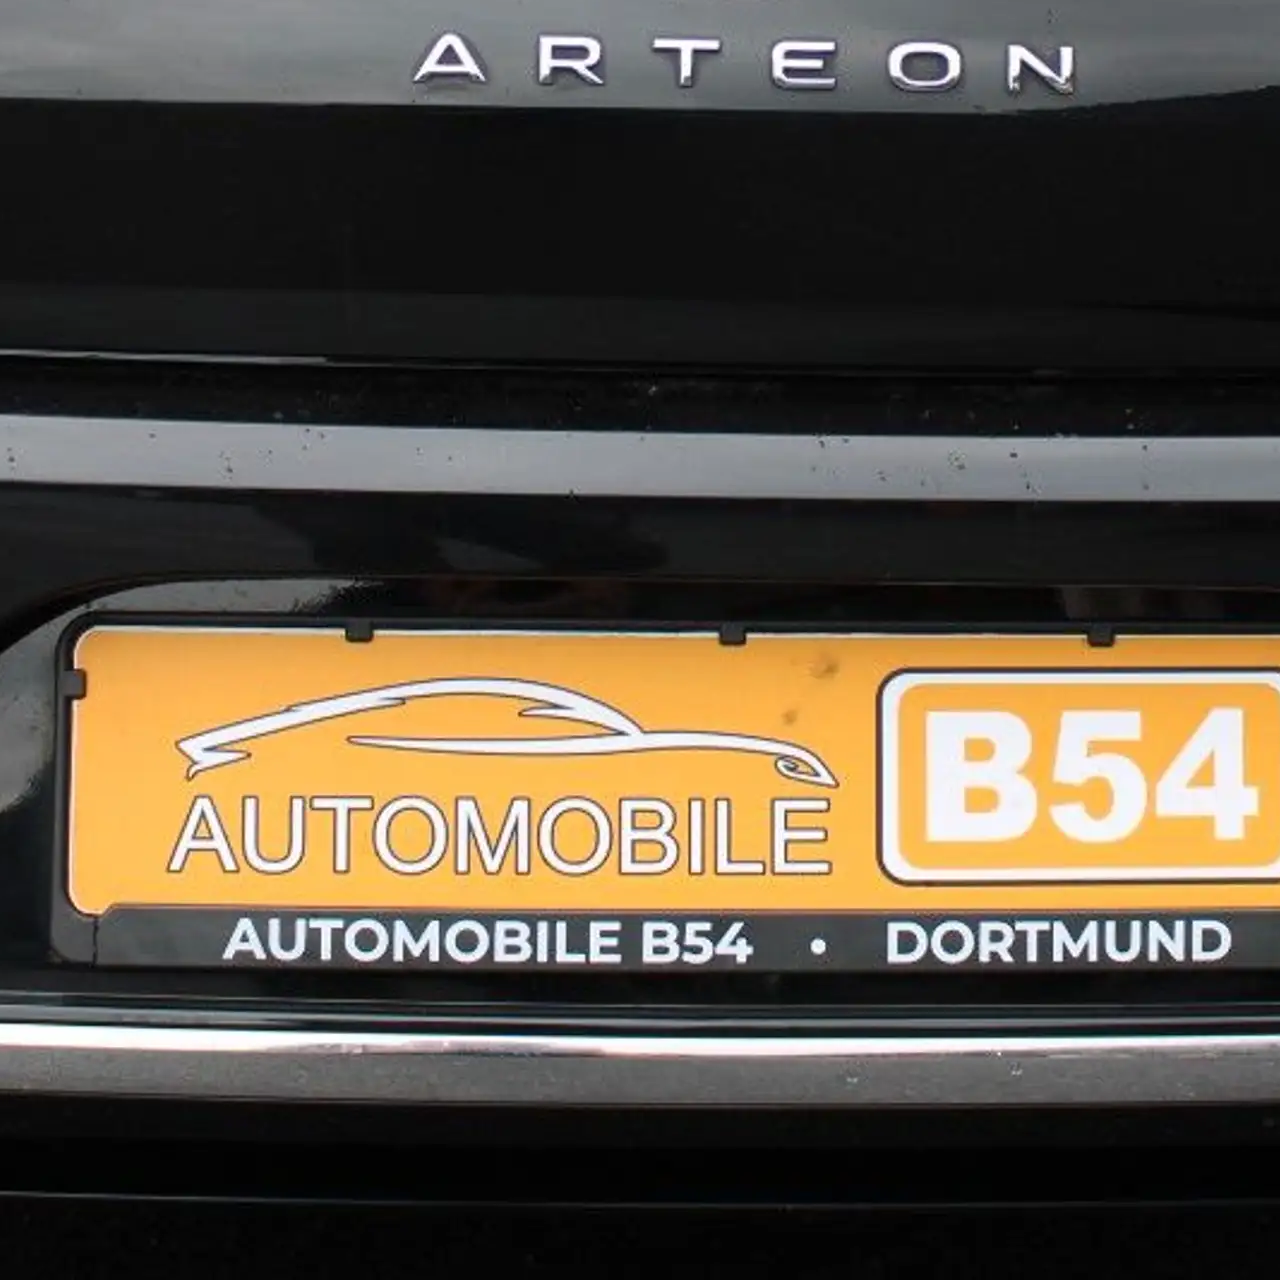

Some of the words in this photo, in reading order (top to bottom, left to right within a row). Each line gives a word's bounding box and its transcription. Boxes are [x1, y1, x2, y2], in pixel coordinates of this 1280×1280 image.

[413, 32, 1075, 93] ARTEON
[924, 706, 1260, 842] B54
[168, 796, 832, 876] AUTOMOBILE
[222, 917, 623, 964] AUTOMOBILE
[640, 920, 755, 964] B54
[886, 920, 1232, 964] DORTMUND
